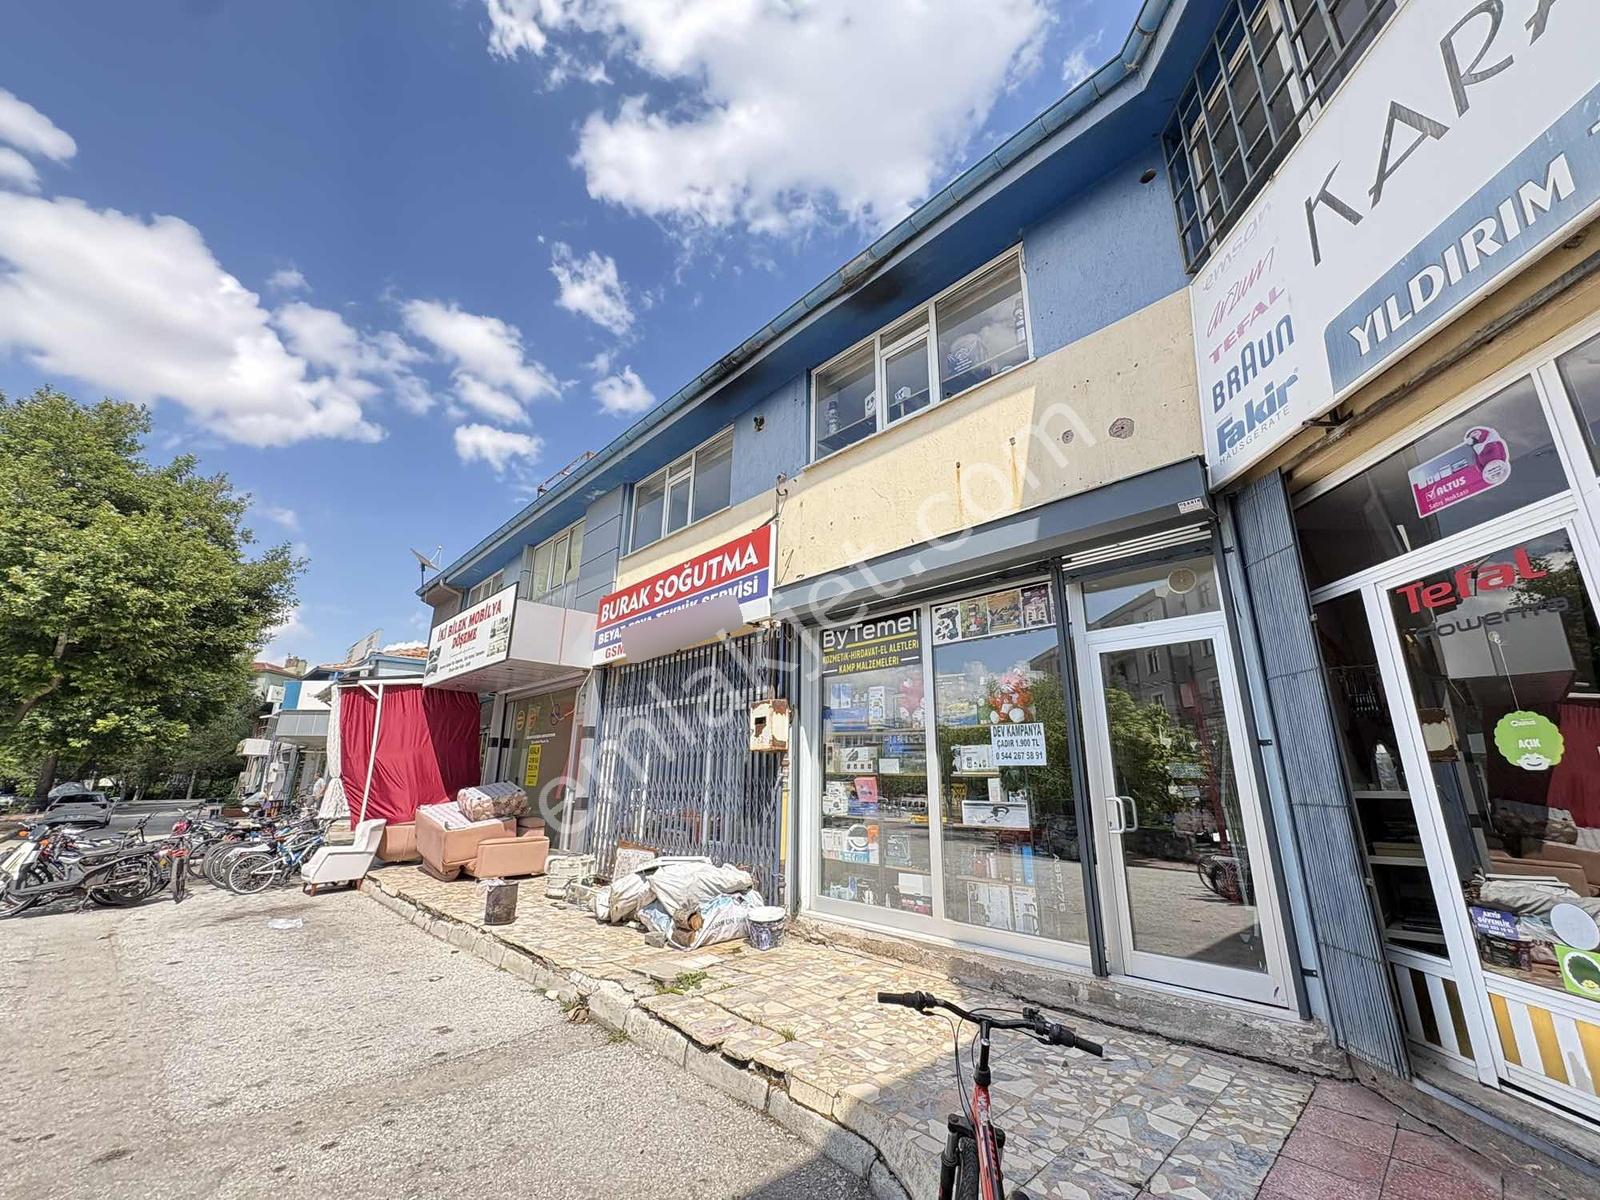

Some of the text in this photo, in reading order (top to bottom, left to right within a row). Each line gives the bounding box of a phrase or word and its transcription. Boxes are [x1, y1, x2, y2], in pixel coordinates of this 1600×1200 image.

[1305, 0, 1557, 267] KAR
[1346, 151, 1577, 357] YILDIRIM
[1209, 286, 1285, 364] TEFAL
[1211, 314, 1295, 414] BRAUN
[1216, 374, 1299, 456] Fakir
[1436, 476, 1466, 496] ALTUS
[600, 542, 759, 624] BURAK SOĞUTMA
[1396, 546, 1548, 614] Tefal
[598, 625, 626, 645] BEYA
[605, 644, 625, 659] GSM
[993, 724, 1042, 738] DEV KAMPANYA
[1031, 738, 1040, 747] TL
